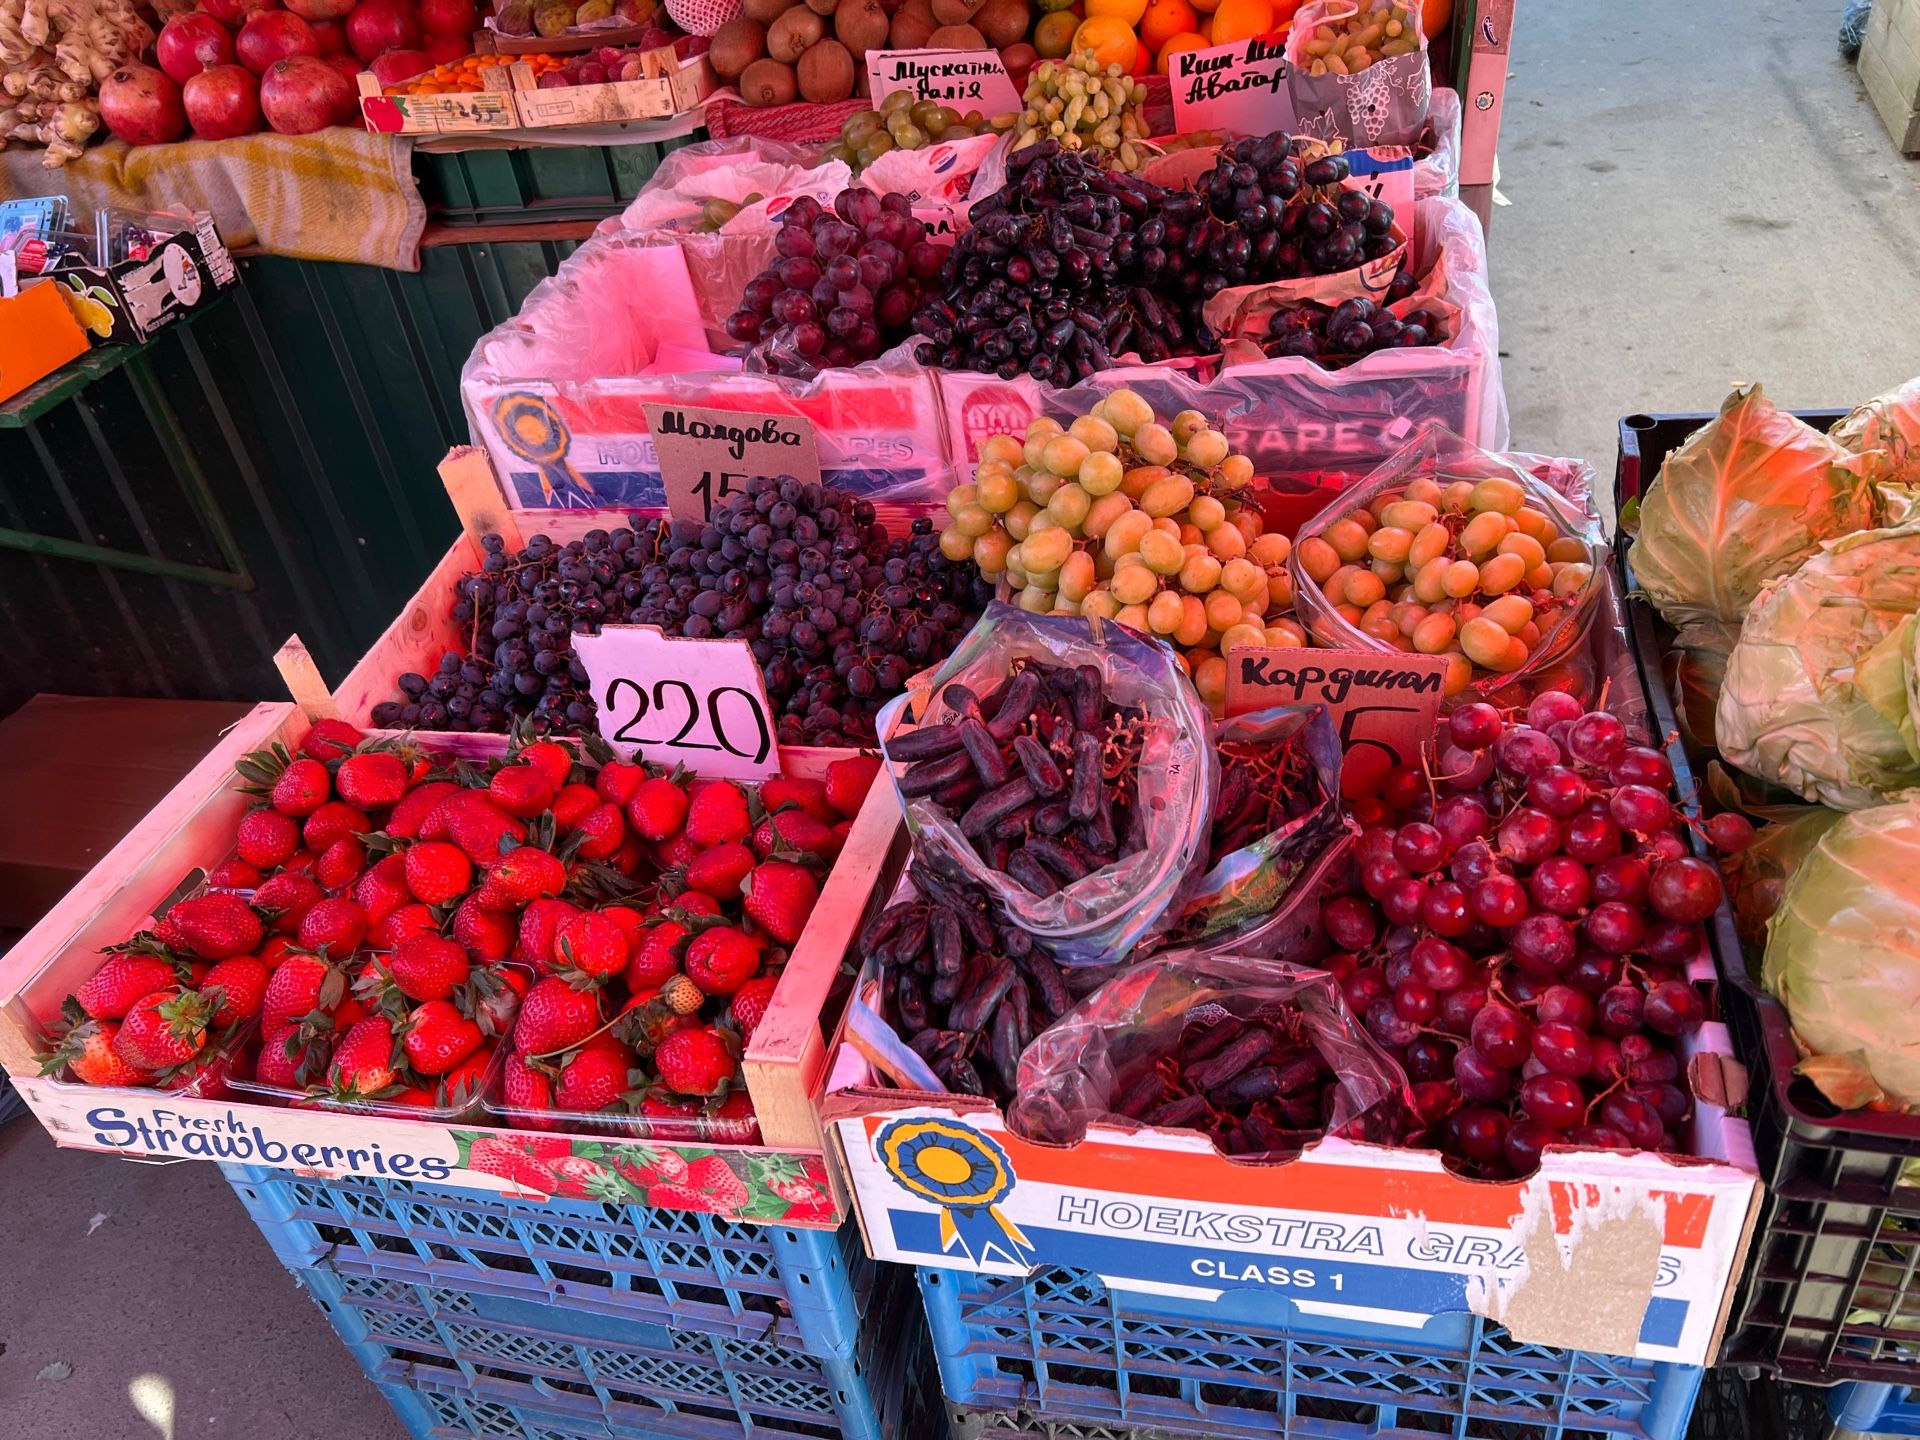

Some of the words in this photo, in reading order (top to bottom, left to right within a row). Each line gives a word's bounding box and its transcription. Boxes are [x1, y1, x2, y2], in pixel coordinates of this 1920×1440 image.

[907, 81, 984, 101] талія
[658, 411, 801, 460] Молдова
[1225, 421, 1368, 453] RAPE
[1241, 657, 1442, 704] Кардинал
[606, 678, 771, 764] 220
[86, 1107, 452, 1180] Strawberries
[152, 1109, 248, 1134] Fresh
[1057, 1195, 1384, 1256] HOEKSTRA
[1190, 1258, 1316, 1287] CLASS
[1329, 1273, 1344, 1291] 1
